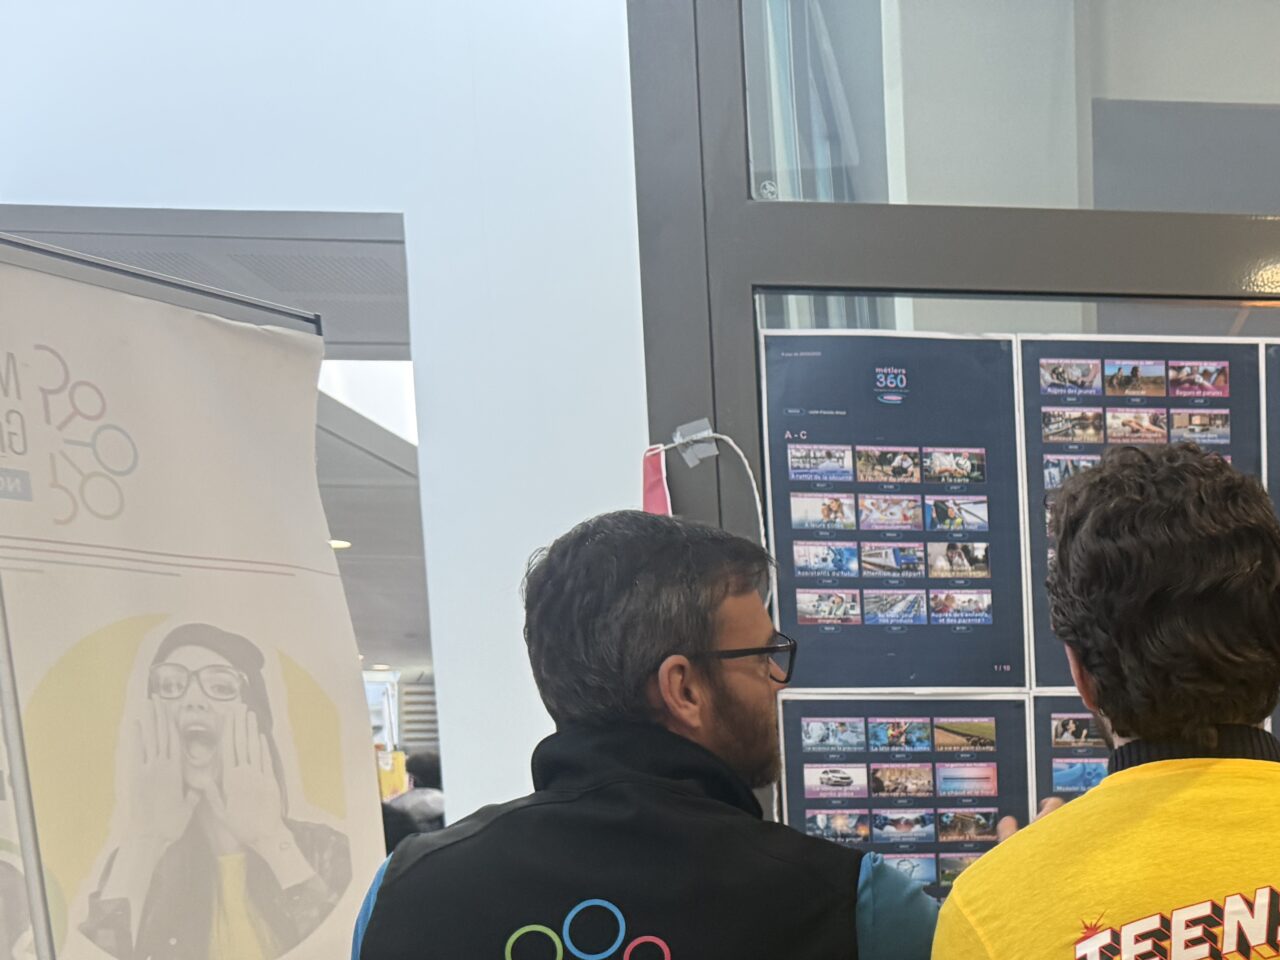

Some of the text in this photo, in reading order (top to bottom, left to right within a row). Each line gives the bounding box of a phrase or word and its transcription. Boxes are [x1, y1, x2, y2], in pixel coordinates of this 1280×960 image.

[875, 366, 907, 374] métiers
[876, 374, 907, 388] 360
[784, 430, 793, 439] A
[800, 430, 807, 439] C
